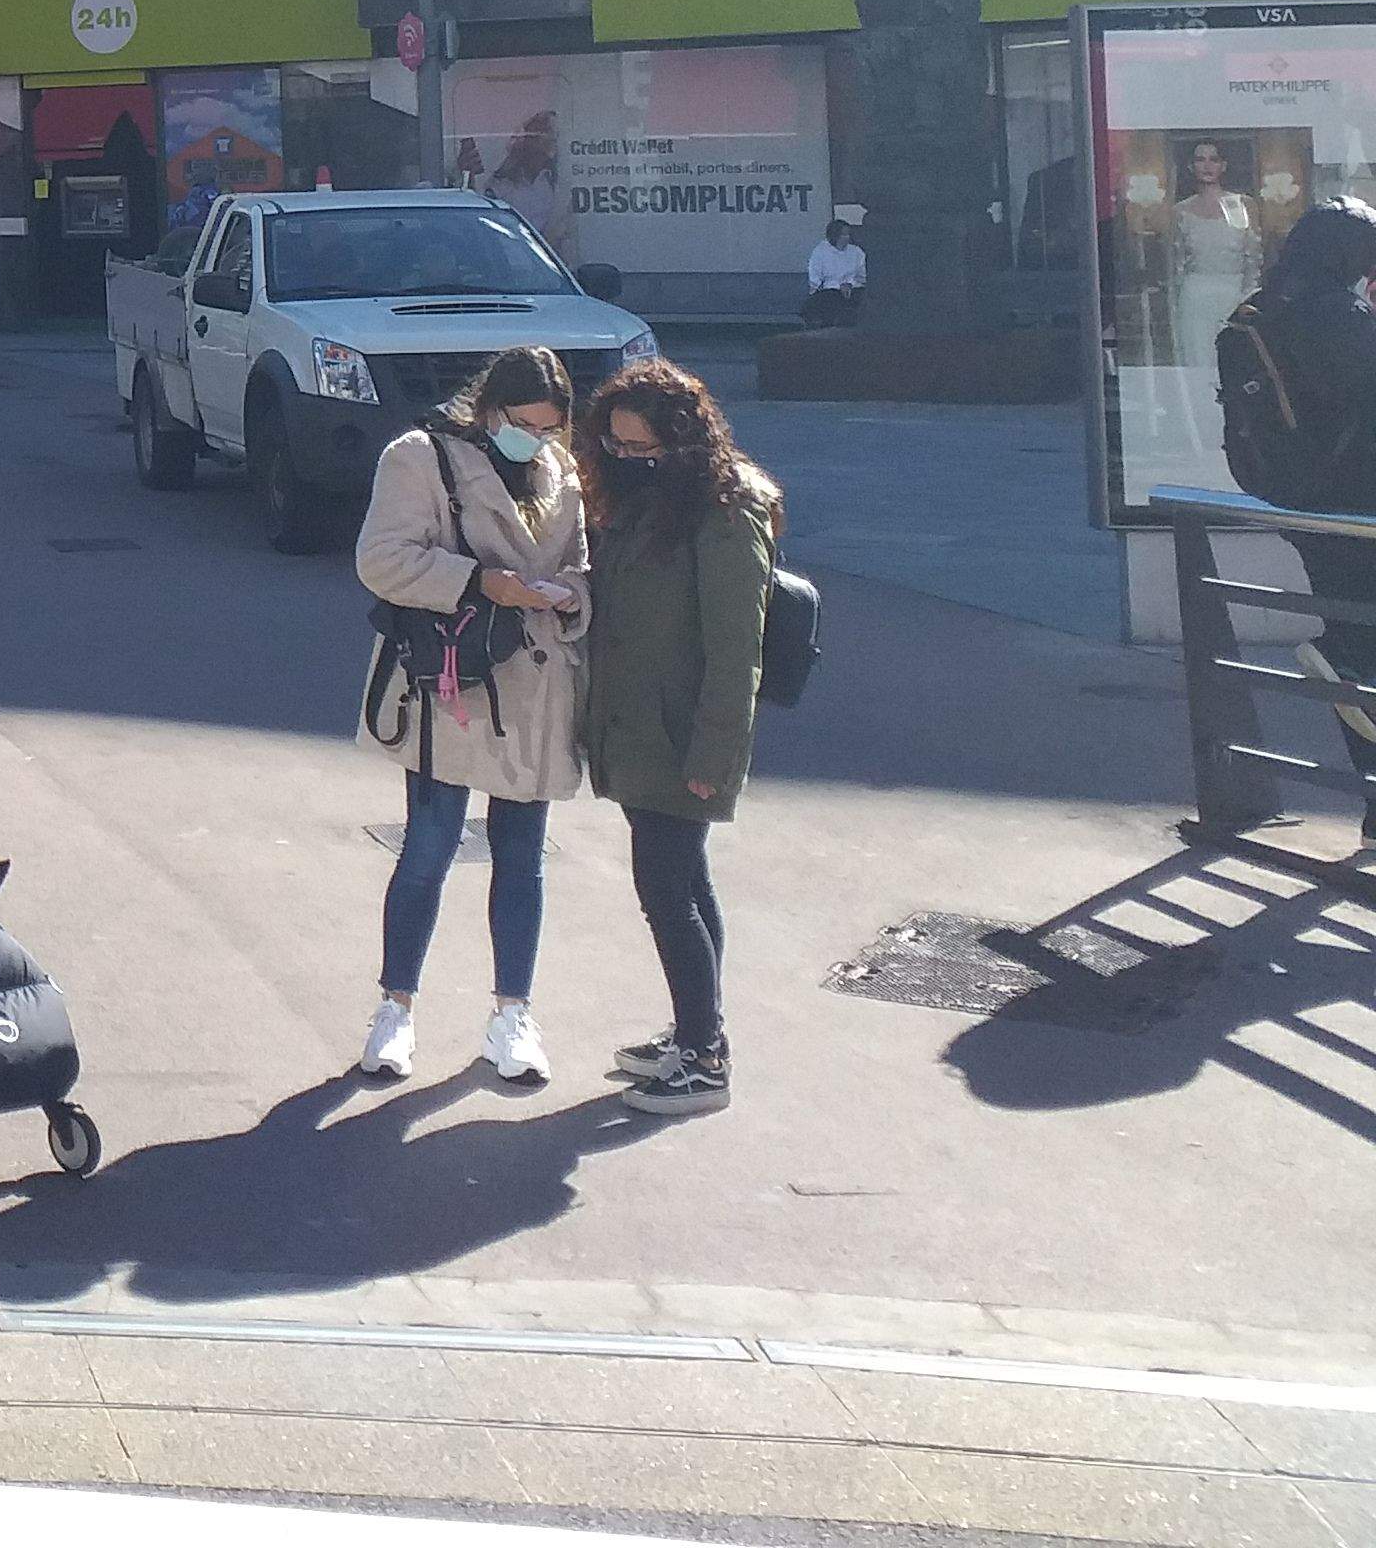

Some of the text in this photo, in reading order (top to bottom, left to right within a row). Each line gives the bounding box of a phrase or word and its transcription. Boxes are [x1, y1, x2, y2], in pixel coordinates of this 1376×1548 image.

[77, 6, 131, 30] 24h
[1229, 79, 1330, 93] PATEK PHILIPPE
[697, 161, 743, 176] portes
[570, 184, 813, 214] DESCOMPLICA'T
